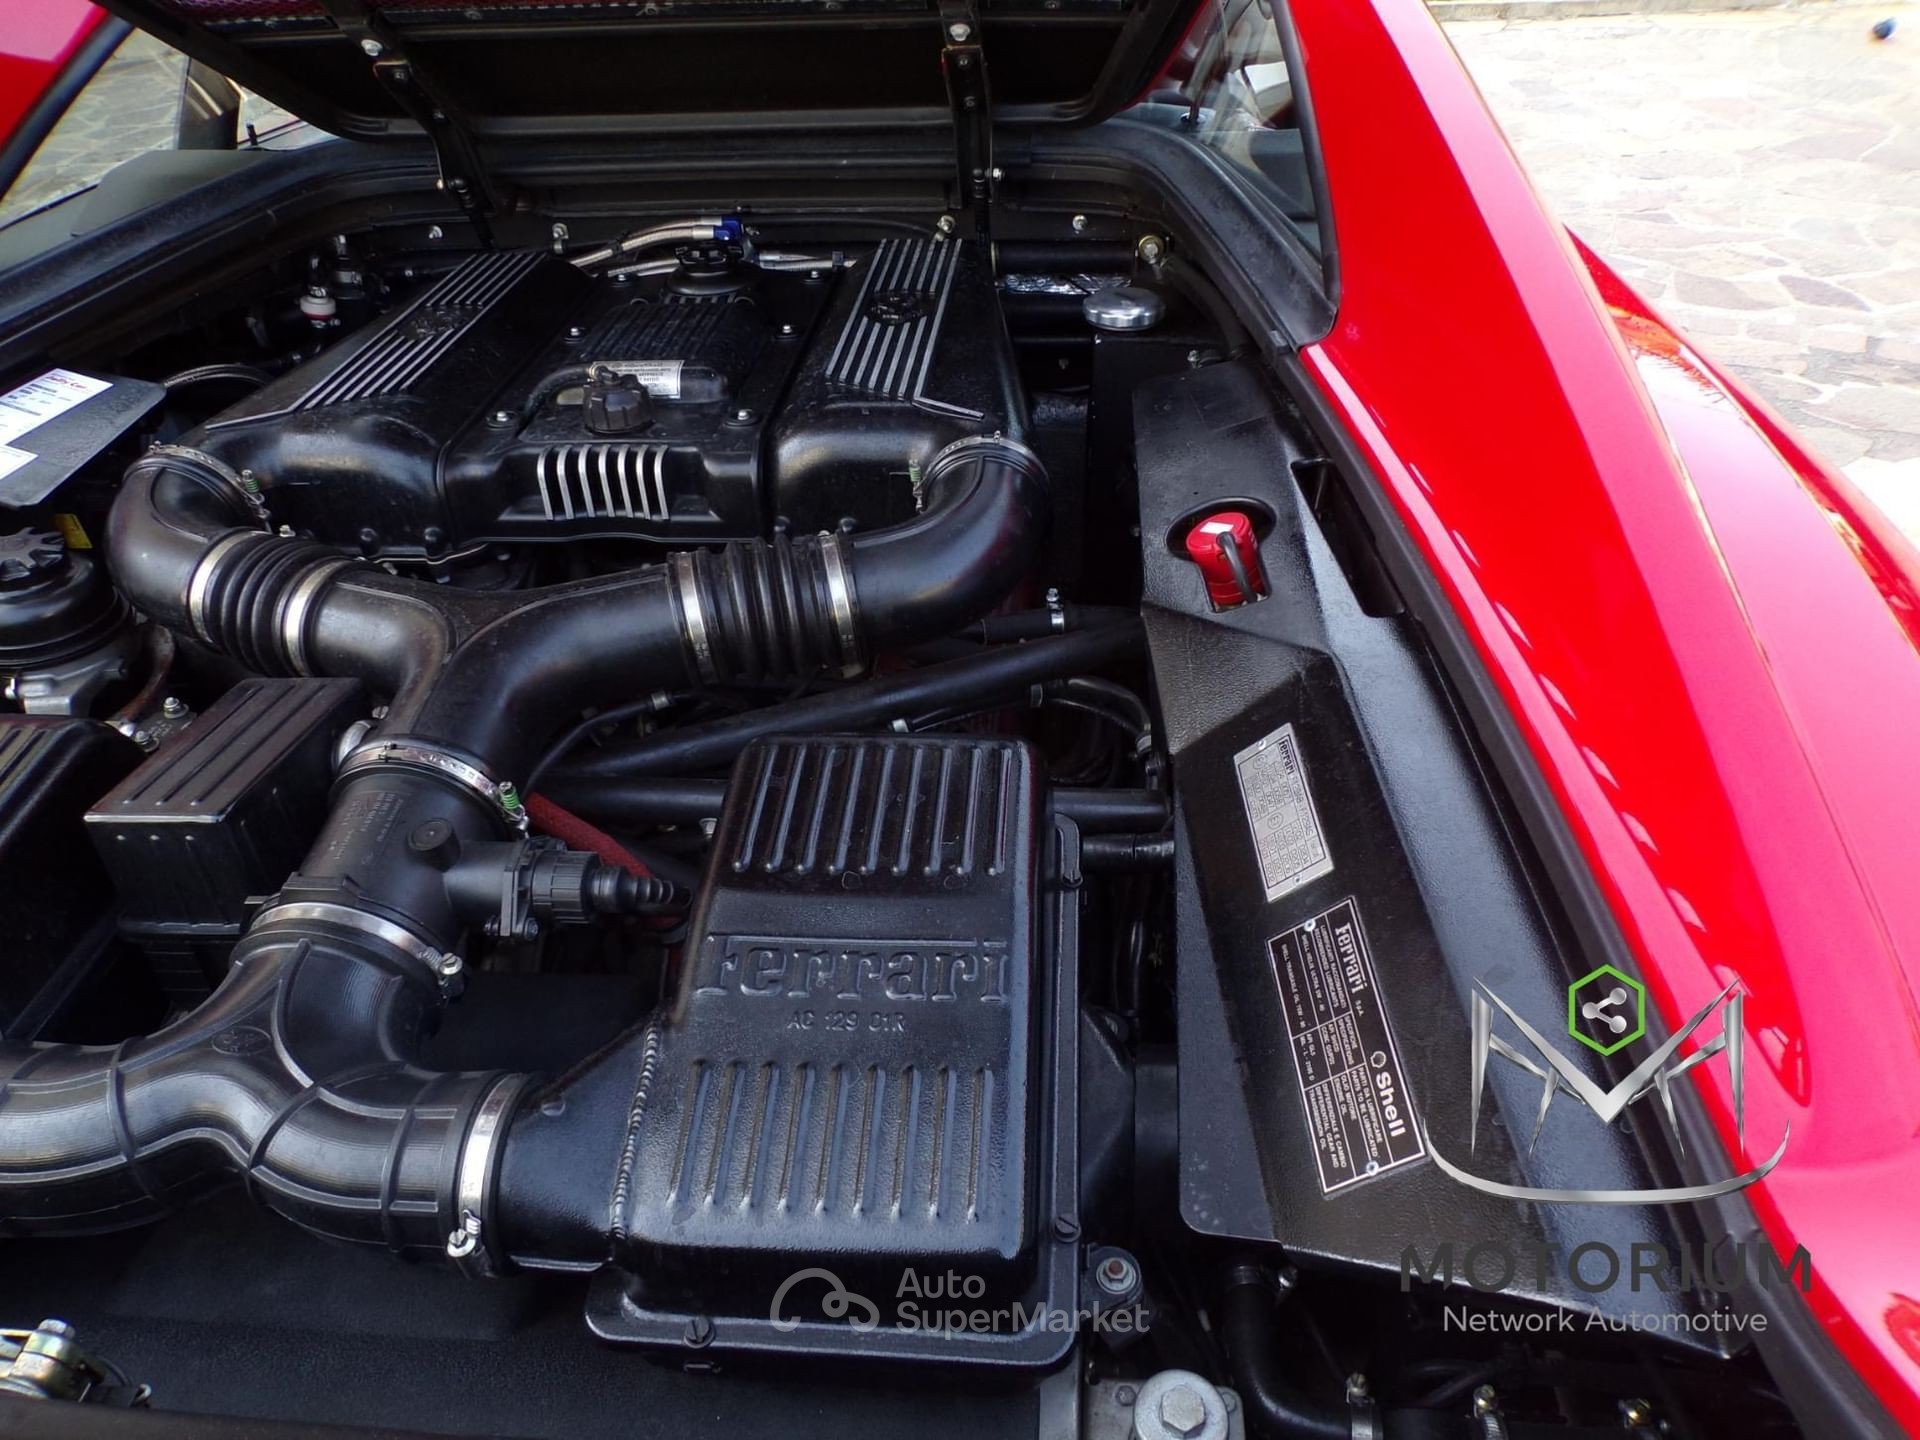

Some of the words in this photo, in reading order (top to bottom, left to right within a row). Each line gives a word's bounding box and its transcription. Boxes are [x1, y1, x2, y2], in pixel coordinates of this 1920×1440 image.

[1278, 738, 1296, 775] Ferrari
[693, 934, 1010, 1002] Ferrari
[1334, 921, 1367, 994] Ferrari
[1324, 970, 1339, 1008] LUBRICANTS
[1340, 1074, 1349, 1091] OLIO
[1350, 1069, 1361, 1092] PARTS
[1357, 1066, 1367, 1087] PARTI
[1363, 1086, 1370, 1098] DA
[1308, 1088, 1324, 1137] TRANSMISSION
[1333, 1077, 1344, 1103] ENGINE
[1339, 1103, 1347, 1115] OIL
[1344, 1091, 1356, 1121] MOTORE
[1356, 1092, 1363, 1102] TO
[1359, 1102, 1366, 1114] BE
[1374, 1069, 1406, 1138] Shell
[1314, 1085, 1330, 1131] DIFFERENTIAL
[1325, 1132, 1335, 1152] GEAR
[1330, 1152, 1339, 1169] AND
[1321, 1082, 1338, 1132] DIFFERENZIALE
[1335, 1139, 1347, 1168] CAMBIO
[1361, 1113, 1378, 1158] LUBRICATED
[1365, 1097, 1382, 1144] LUBRIFICARE
